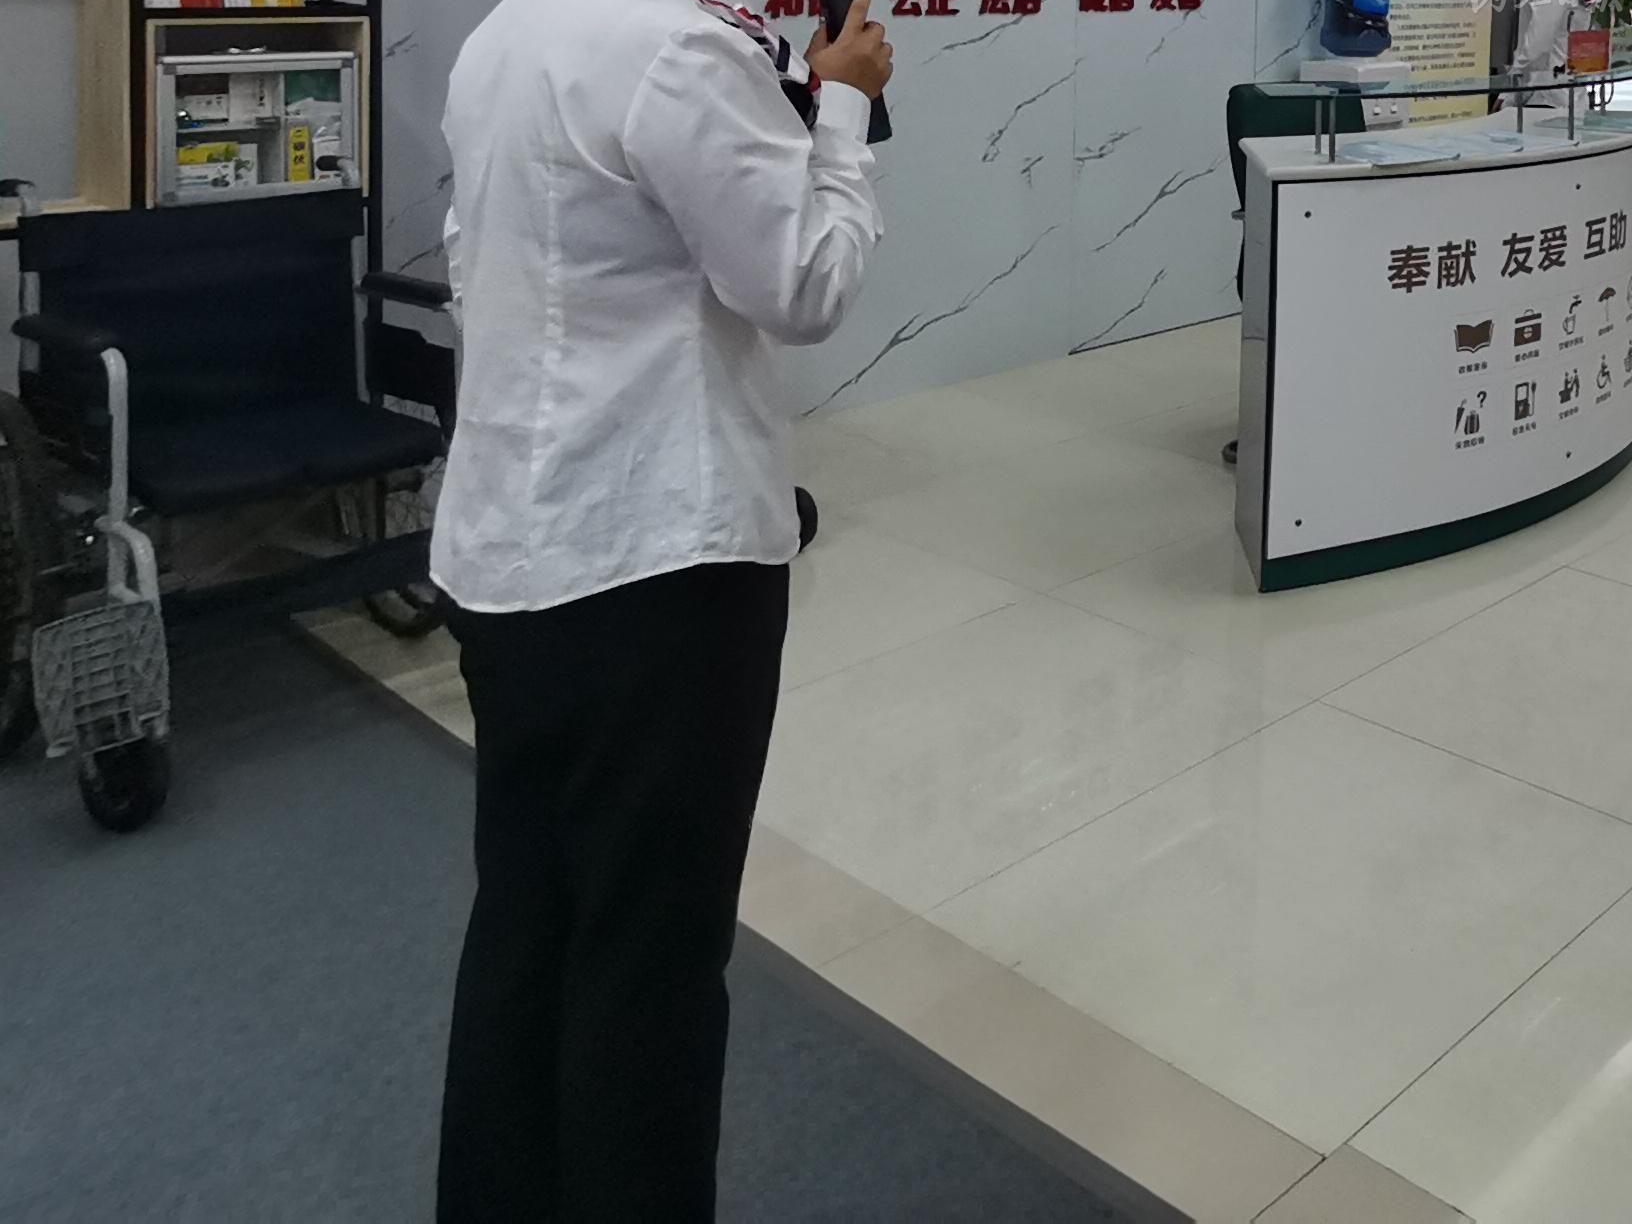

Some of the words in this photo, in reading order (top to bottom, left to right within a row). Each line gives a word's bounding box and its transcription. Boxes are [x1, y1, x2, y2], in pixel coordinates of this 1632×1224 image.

[1387, 239, 1478, 293] 奉献
[1500, 225, 1568, 278] 友爱
[1584, 209, 1628, 261] 互助
